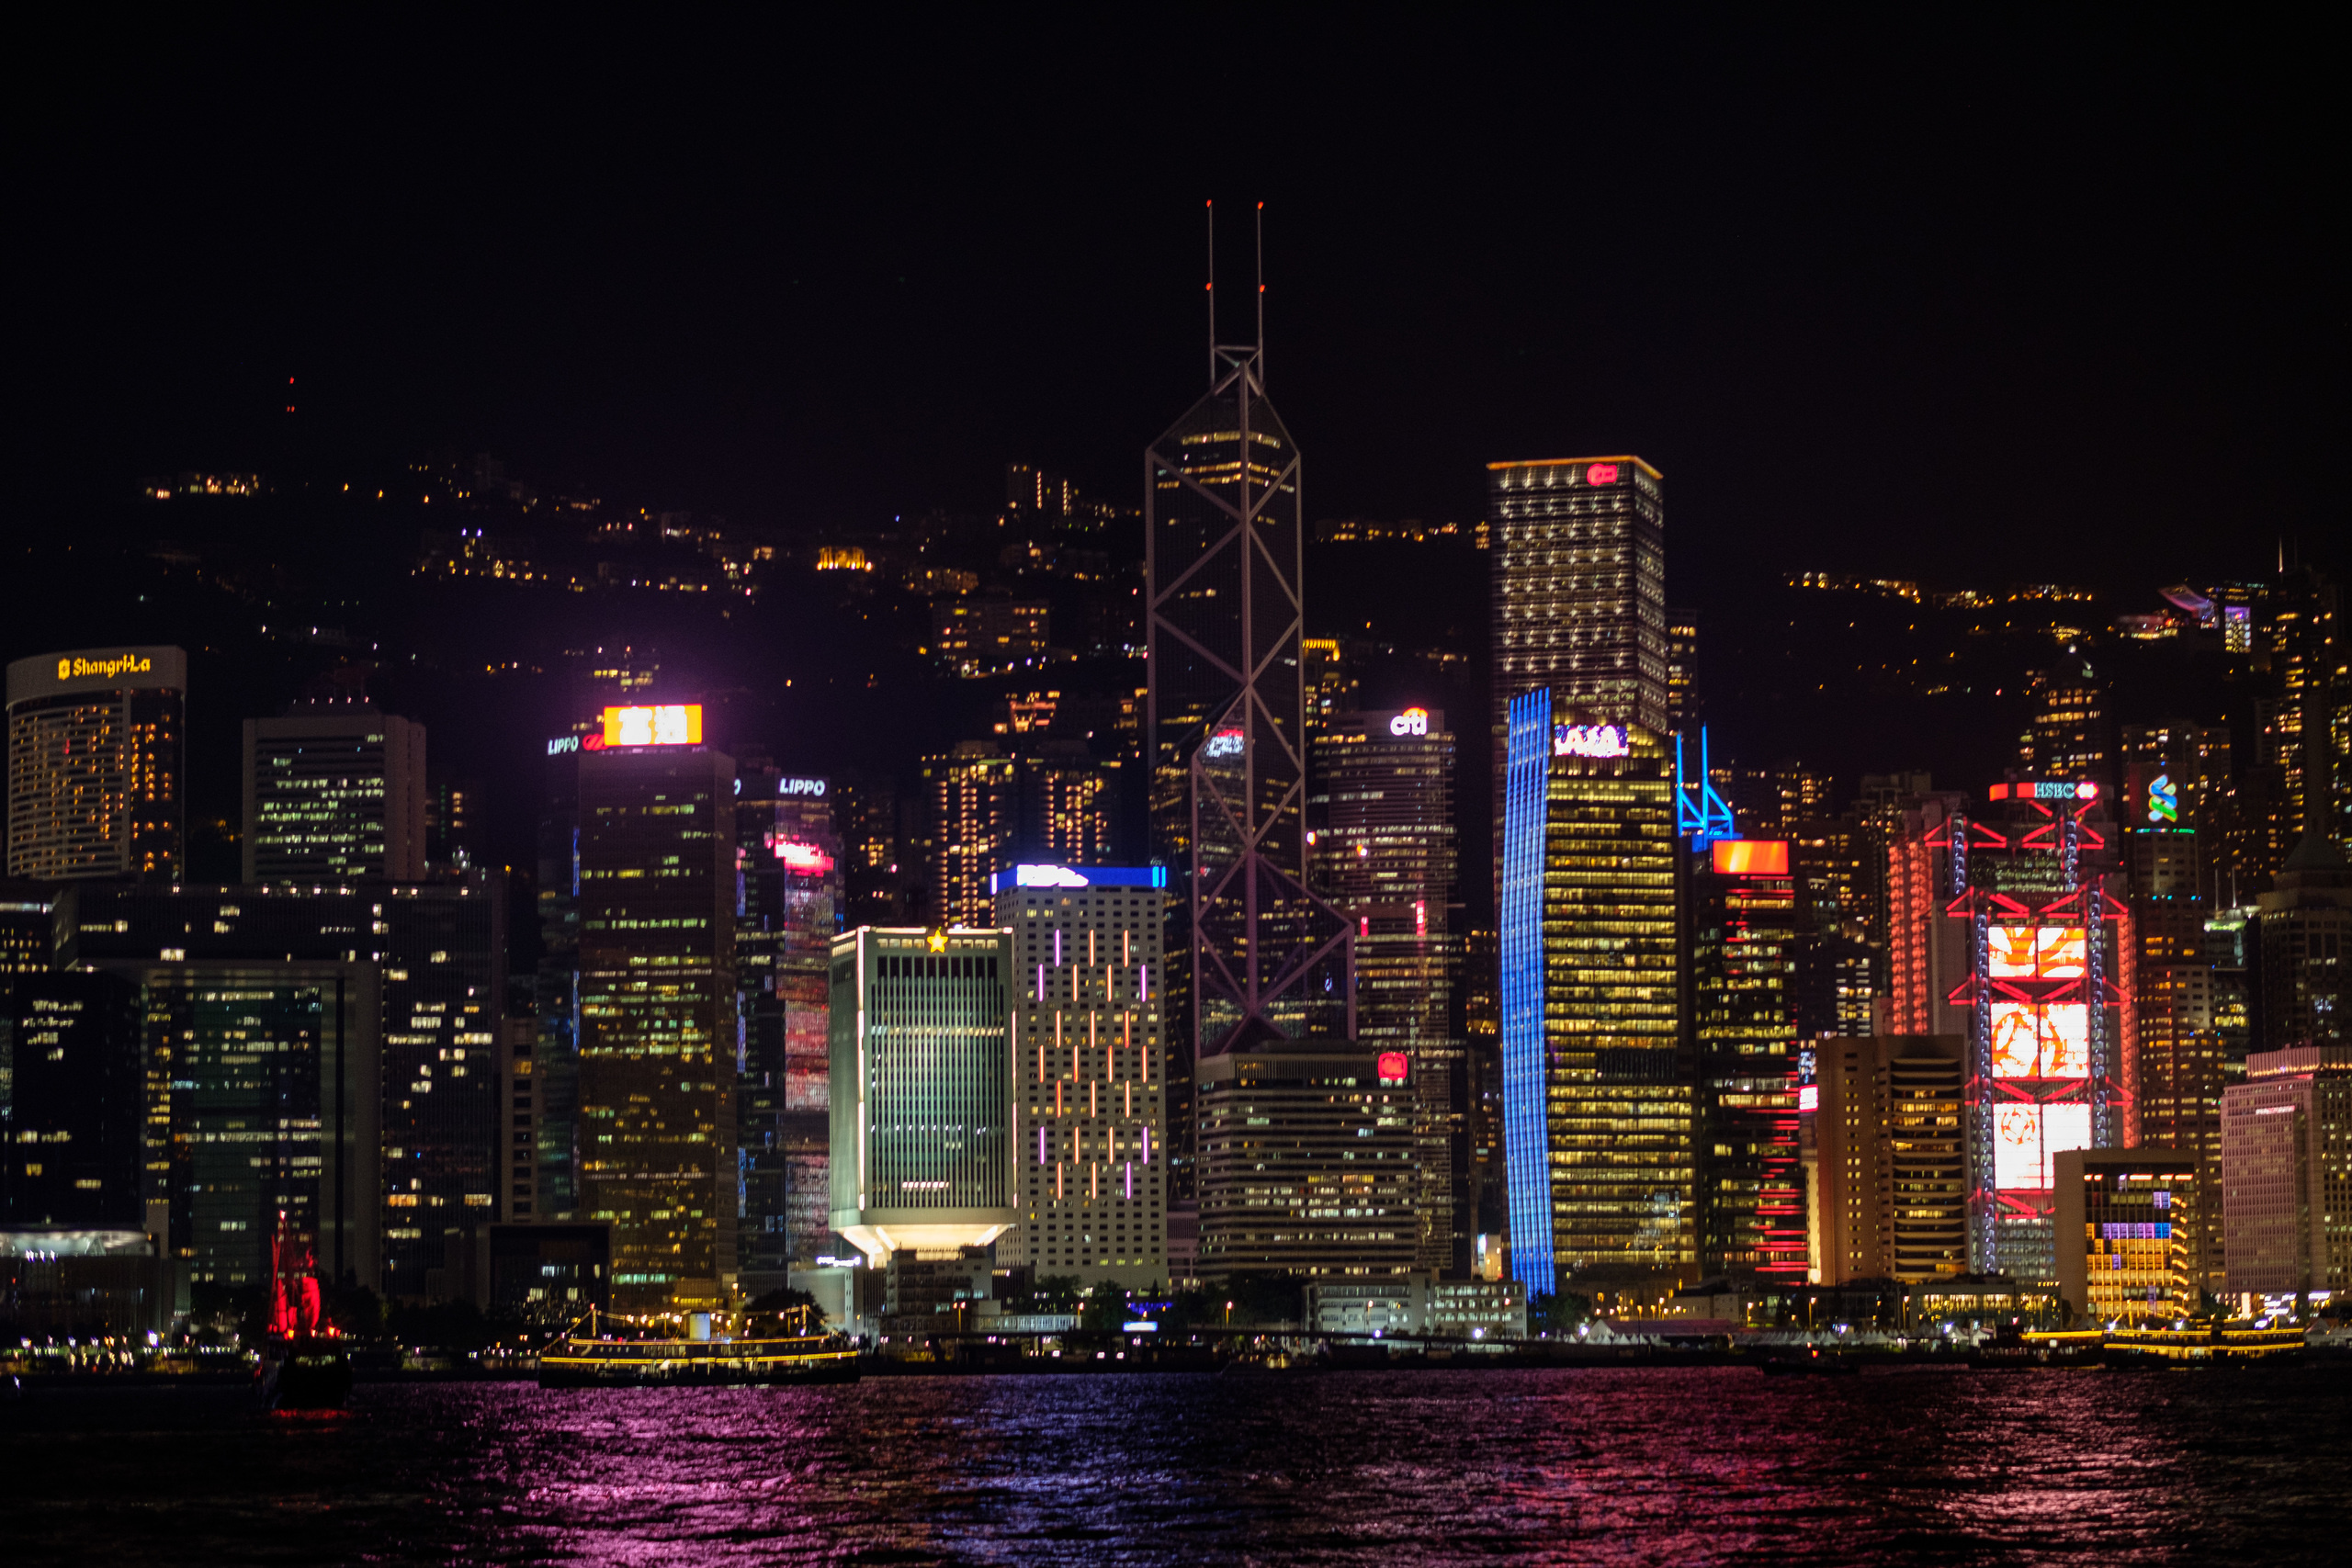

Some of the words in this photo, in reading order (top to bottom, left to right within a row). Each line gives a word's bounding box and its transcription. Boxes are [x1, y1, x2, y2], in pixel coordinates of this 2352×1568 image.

[548, 735, 579, 756] LIPPO
[779, 777, 826, 796] LIPPO
[2034, 782, 2075, 799] HSBC
